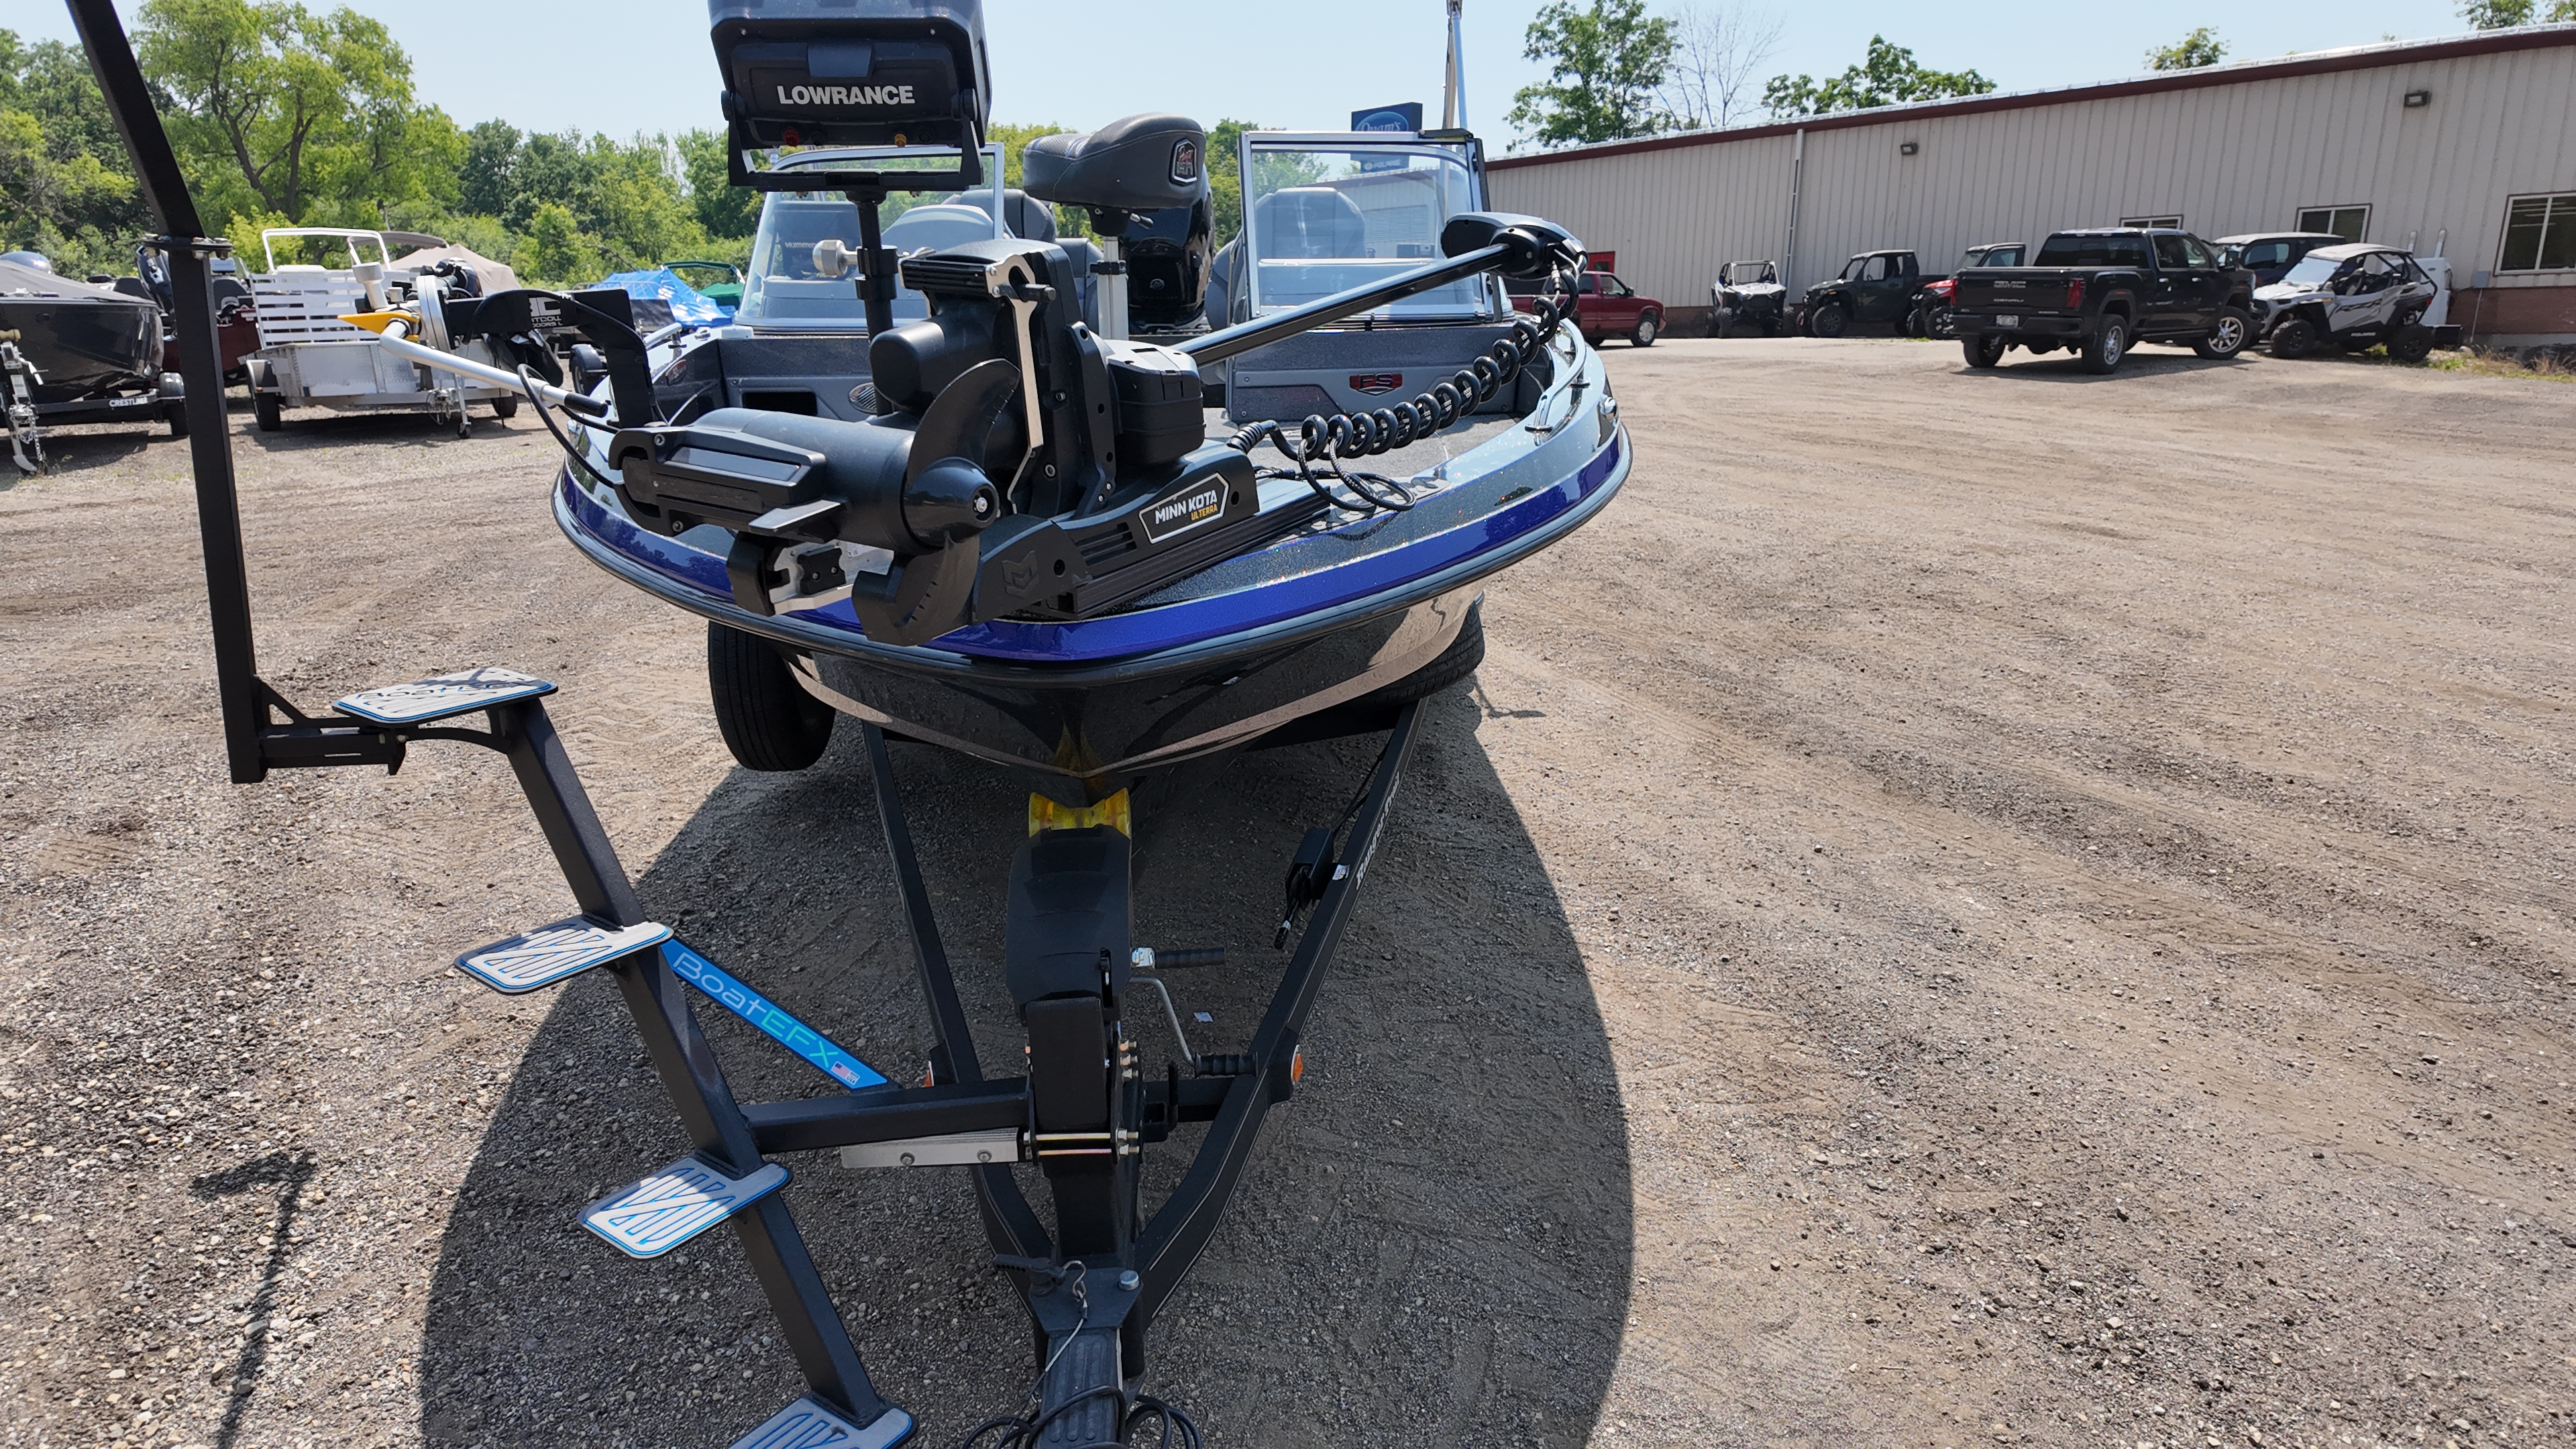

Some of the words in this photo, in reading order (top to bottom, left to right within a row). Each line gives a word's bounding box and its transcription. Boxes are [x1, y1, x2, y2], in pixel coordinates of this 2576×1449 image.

[777, 85, 915, 105] LOWRANCE
[1359, 373, 1393, 388] FS
[109, 396, 148, 407] CRESTLINER
[1155, 500, 1187, 524] MINN
[1188, 490, 1218, 512] KOTA
[1191, 504, 1218, 521] ULTERRA
[673, 952, 839, 1068] BoatEFX
